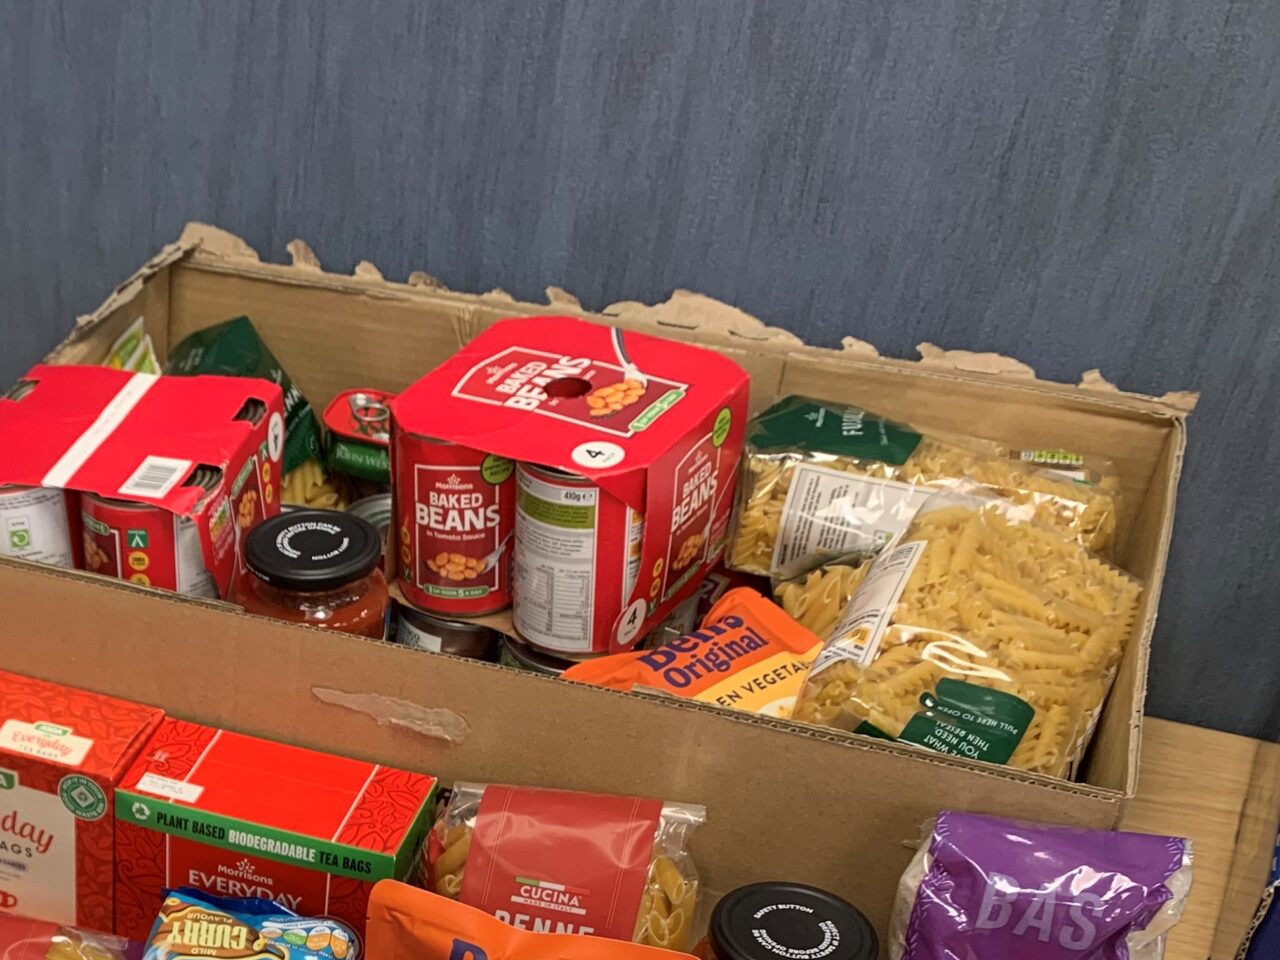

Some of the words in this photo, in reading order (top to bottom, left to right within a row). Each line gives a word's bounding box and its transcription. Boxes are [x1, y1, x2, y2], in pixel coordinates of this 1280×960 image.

[496, 361, 548, 394] BAKED
[365, 455, 389, 469] WES
[682, 462, 712, 498] BAKED
[429, 491, 483, 508] BAKED
[671, 470, 719, 533] BEANS
[416, 502, 500, 532] BEANS
[663, 627, 768, 688] Original
[937, 705, 960, 717] OPEN
[961, 712, 974, 721] TO
[976, 716, 998, 728] HERE
[999, 721, 1018, 735] PULL
[958, 741, 980, 760] YOU
[968, 734, 990, 752] THEN
[157, 812, 189, 831] PLANT
[192, 820, 225, 840] BASED
[228, 829, 316, 863] BIODEGRADABLE
[319, 851, 339, 867] TEA
[343, 857, 372, 875] BAGS
[218, 864, 273, 885] Morrisons
[189, 870, 303, 910] EVERYDAY
[520, 885, 579, 907] CUCINA
[187, 912, 233, 922] FLAVOUR
[777, 904, 814, 914] BUTTON
[974, 871, 1106, 950] BAS
[168, 923, 247, 950] CURRY
[757, 937, 772, 950] CAN
[191, 947, 216, 956] MILD
[772, 948, 810, 959] BUTTON
